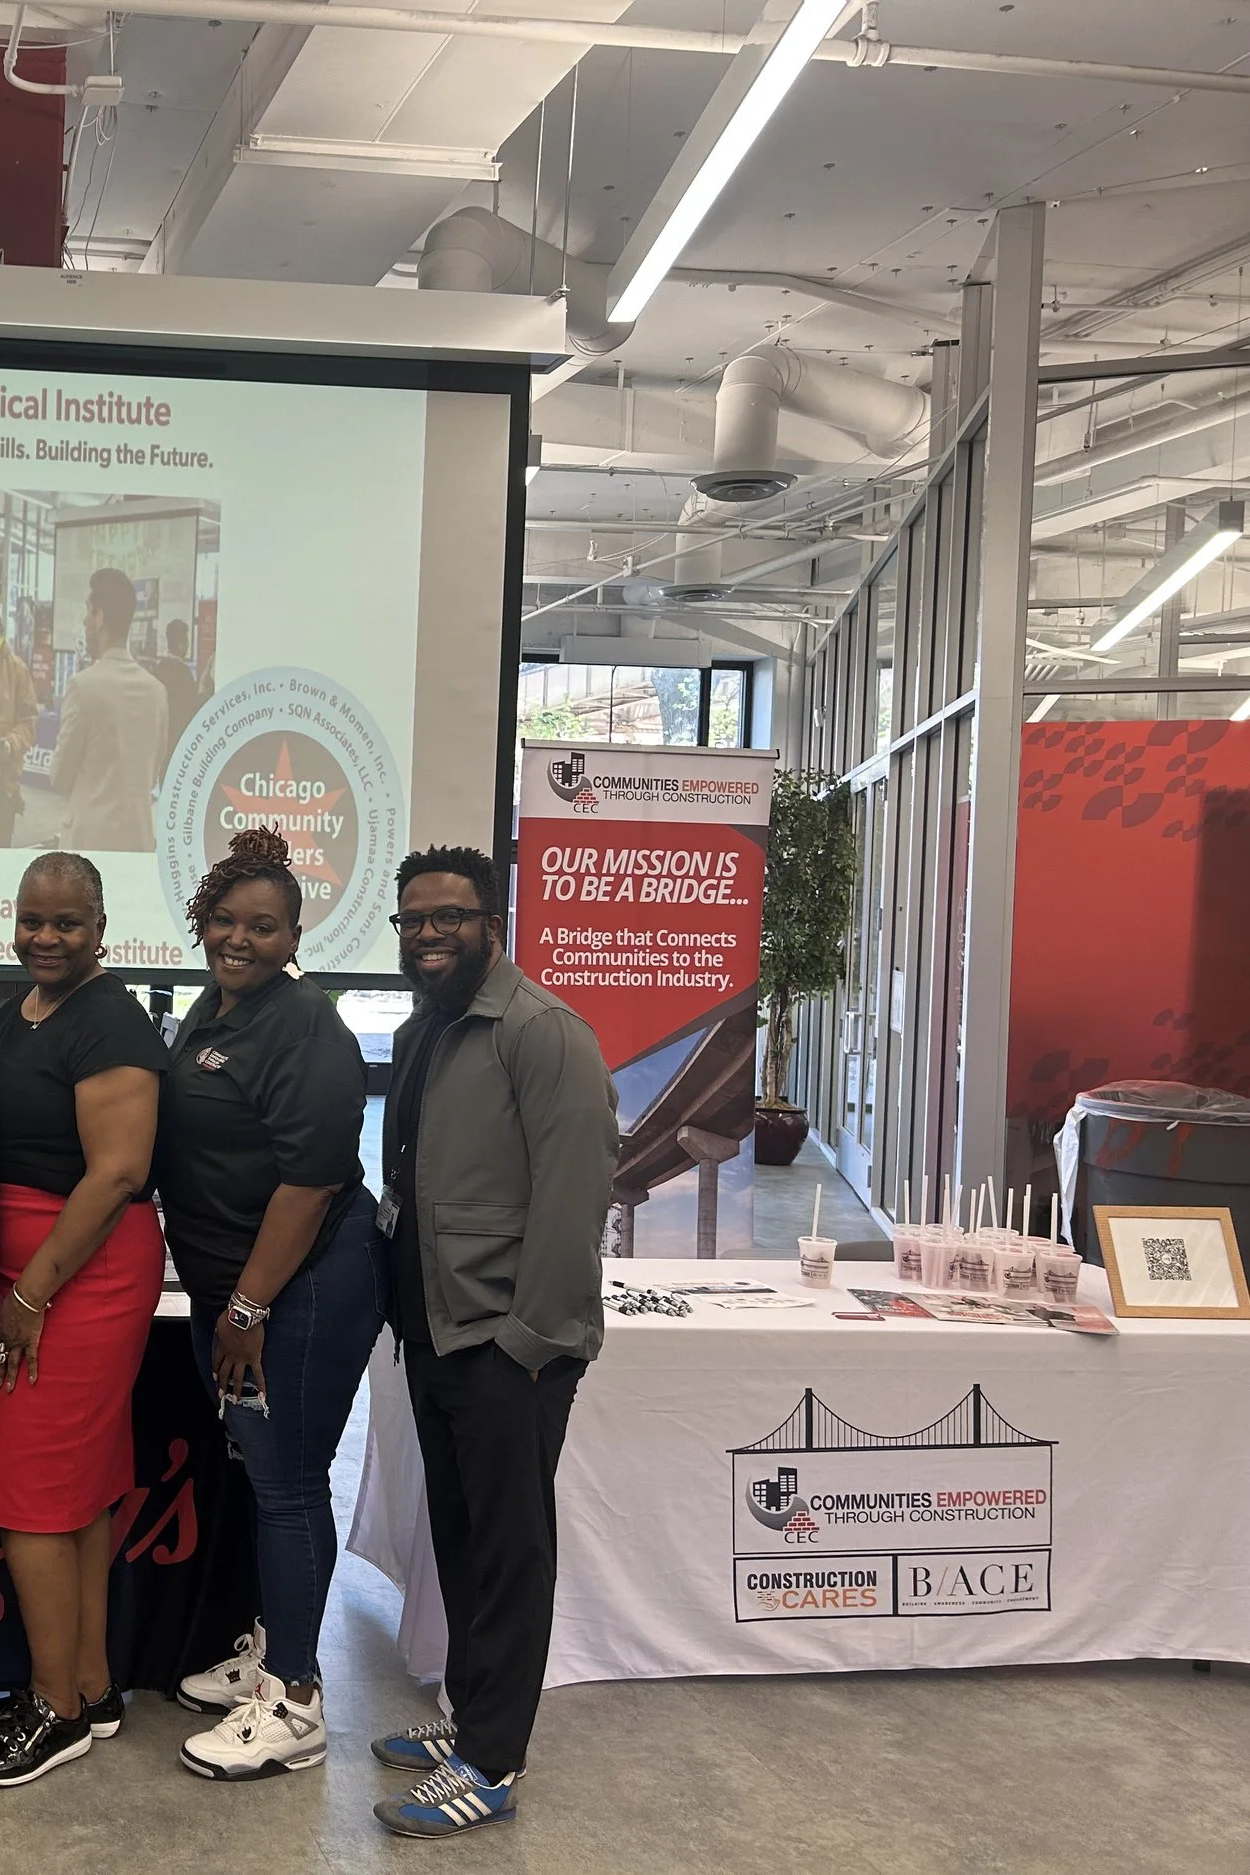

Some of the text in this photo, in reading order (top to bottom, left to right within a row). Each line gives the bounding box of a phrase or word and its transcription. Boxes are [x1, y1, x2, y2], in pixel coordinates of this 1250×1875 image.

[56, 389, 172, 427] Institute
[36, 439, 112, 469] Building
[116, 446, 146, 466] the
[151, 444, 214, 470] Future.
[289, 678, 387, 784] Brown & Momen, Inc.
[166, 733, 204, 831] Construction
[202, 691, 251, 733] Services,
[253, 682, 276, 696] Inc.
[288, 702, 374, 792] SQN Associates, LLC
[183, 790, 199, 847] Gilbane
[192, 737, 227, 788] Building
[224, 706, 275, 738] Company
[240, 772, 326, 805] Chicago
[592, 776, 760, 795] COMMUNITIES EMPOWERED
[573, 803, 600, 814] CEC
[603, 790, 752, 805] THROUGH CONSTRUCTION
[219, 806, 345, 840] Community
[366, 809, 380, 866] Ujamaa
[384, 808, 397, 866] Powers
[541, 846, 739, 877] OUR MISSION IS
[377, 870, 391, 901] and
[542, 875, 749, 905] TO BE A BRIDGE...
[324, 868, 375, 944] Construction,
[539, 927, 737, 950] A Bridge that Connects
[552, 948, 724, 967] Communities to the
[540, 968, 734, 992] Construction Industry.
[810, 1488, 1047, 1511] COMMUNITIES EMPOWERED
[824, 1506, 1036, 1525] THROUGH CONSTRUCTION
[784, 1531, 820, 1544] CEC
[747, 1570, 877, 1591] CONSTRUCTION
[908, 1563, 1034, 1598] B/ACE
[782, 1588, 878, 1609] CARES
